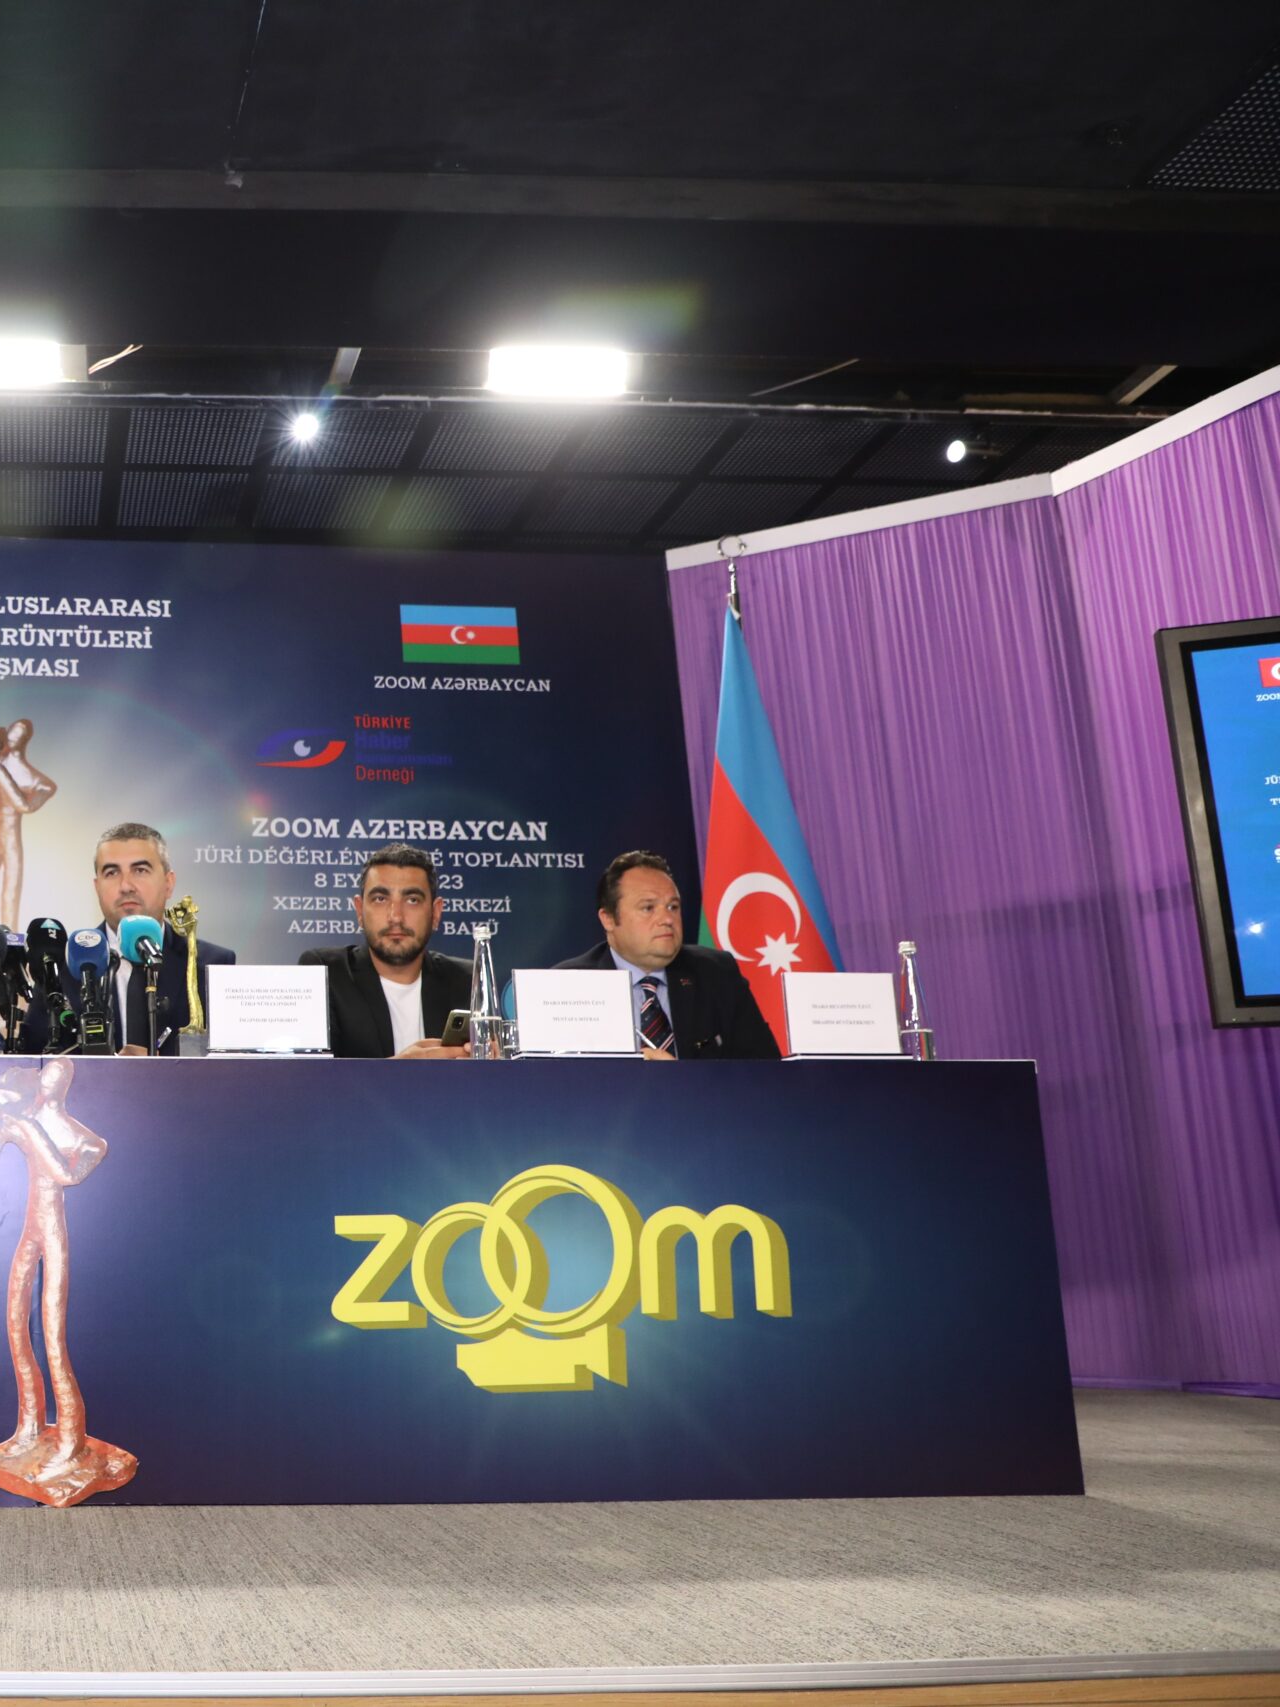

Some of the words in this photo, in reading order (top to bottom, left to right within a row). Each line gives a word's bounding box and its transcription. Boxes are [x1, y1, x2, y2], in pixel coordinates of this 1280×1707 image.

[374, 675, 427, 690] ZOOM
[431, 677, 551, 692] AZƏRBAYCAN
[353, 713, 411, 729] TÜRKİYE
[354, 730, 411, 750] Haber
[355, 765, 415, 785] Derneği
[252, 817, 340, 839] ZOOM
[347, 819, 547, 842] AZERBAYCAN
[193, 847, 243, 864] JÜRİ
[449, 851, 585, 869] TOPLANTISI
[314, 873, 327, 888] 8
[438, 874, 464, 890] 23
[273, 895, 342, 912] XEZER
[441, 894, 511, 914] ERKEZİ
